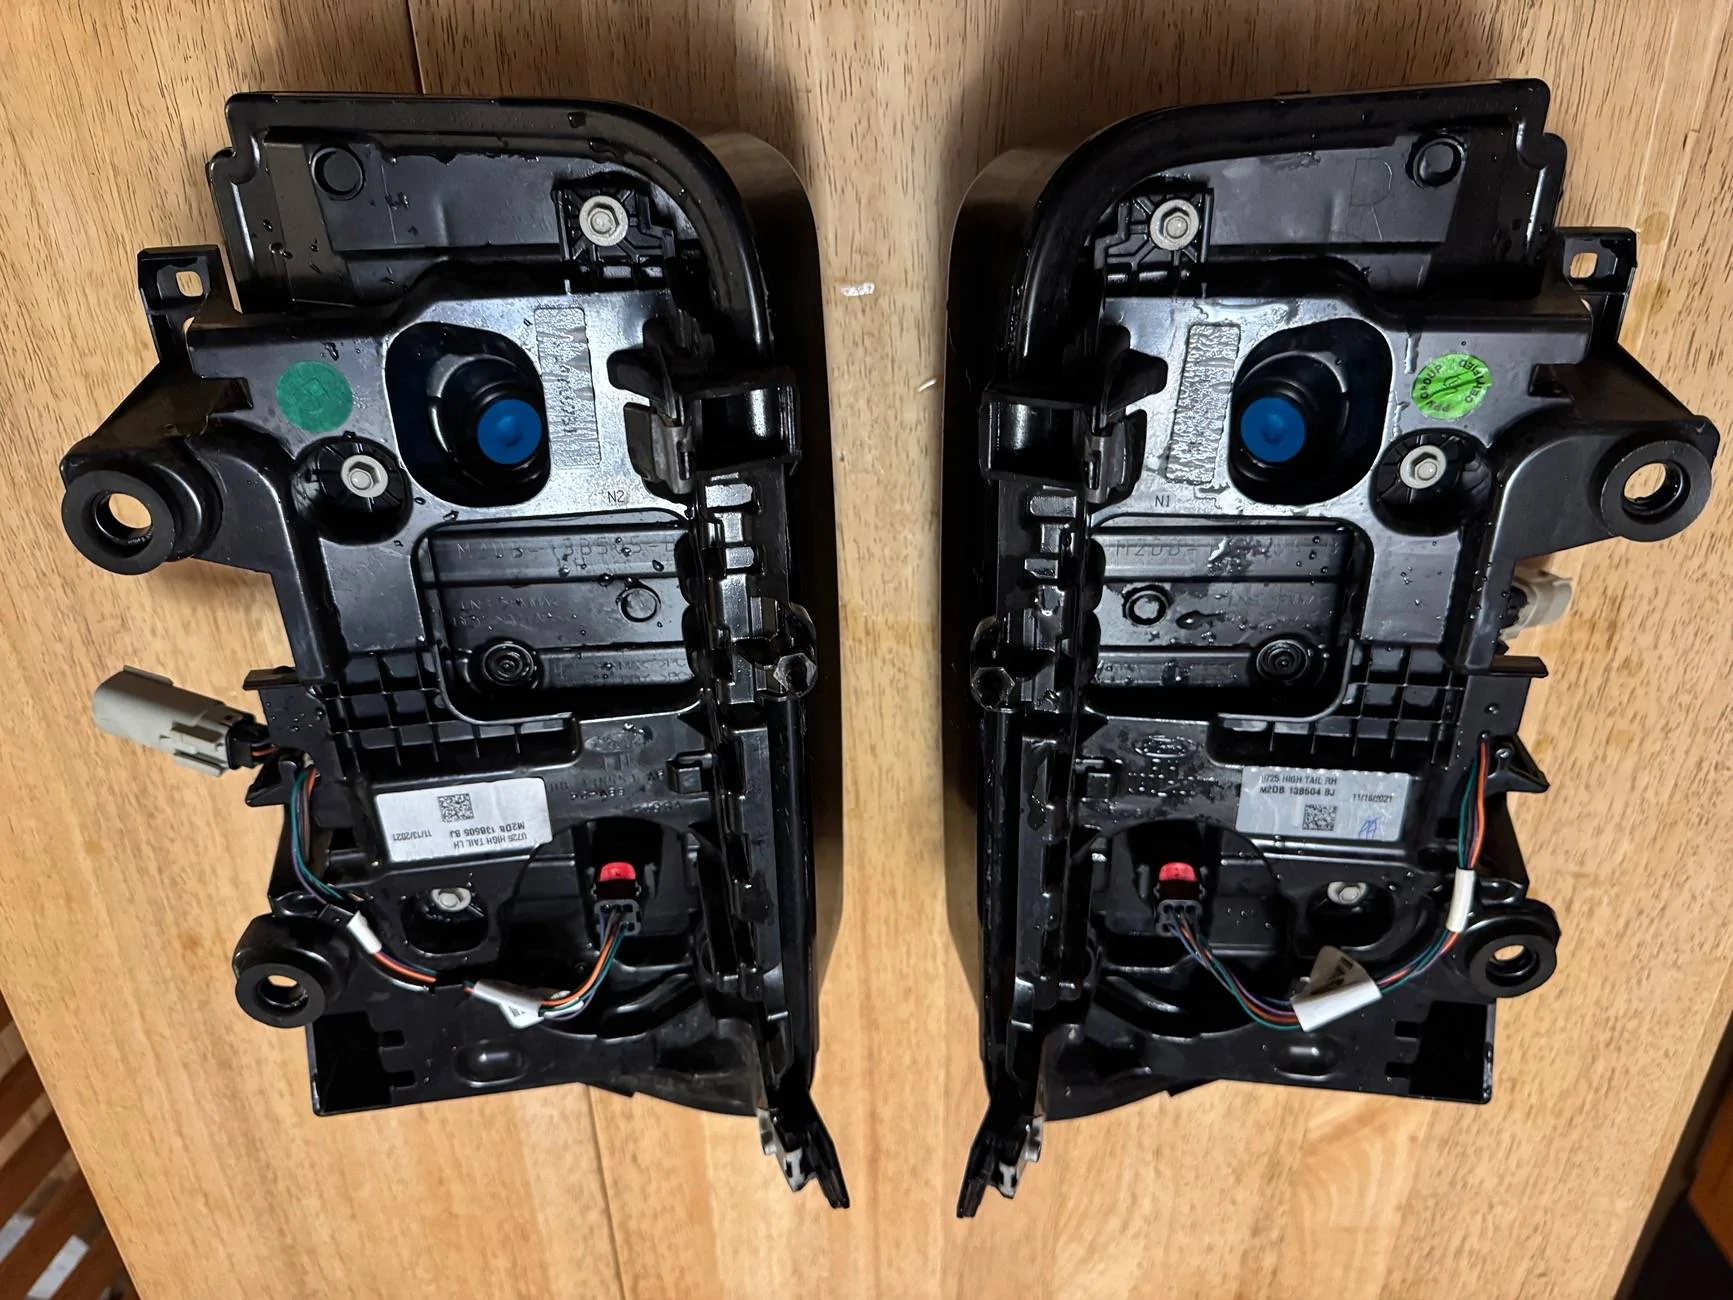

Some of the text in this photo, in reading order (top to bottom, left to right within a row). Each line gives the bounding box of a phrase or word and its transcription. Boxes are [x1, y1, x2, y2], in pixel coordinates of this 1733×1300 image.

[607, 490, 625, 503] N2
[1282, 775, 1303, 784] HIGH
[1305, 776, 1322, 785] TAIL
[1324, 776, 1337, 785] RH
[1259, 785, 1336, 797] M2DB 13B504 BJ
[450, 828, 462, 838] BJ
[499, 821, 525, 833] M2DB
[453, 832, 527, 849] U725 HIGH TAIL LH
